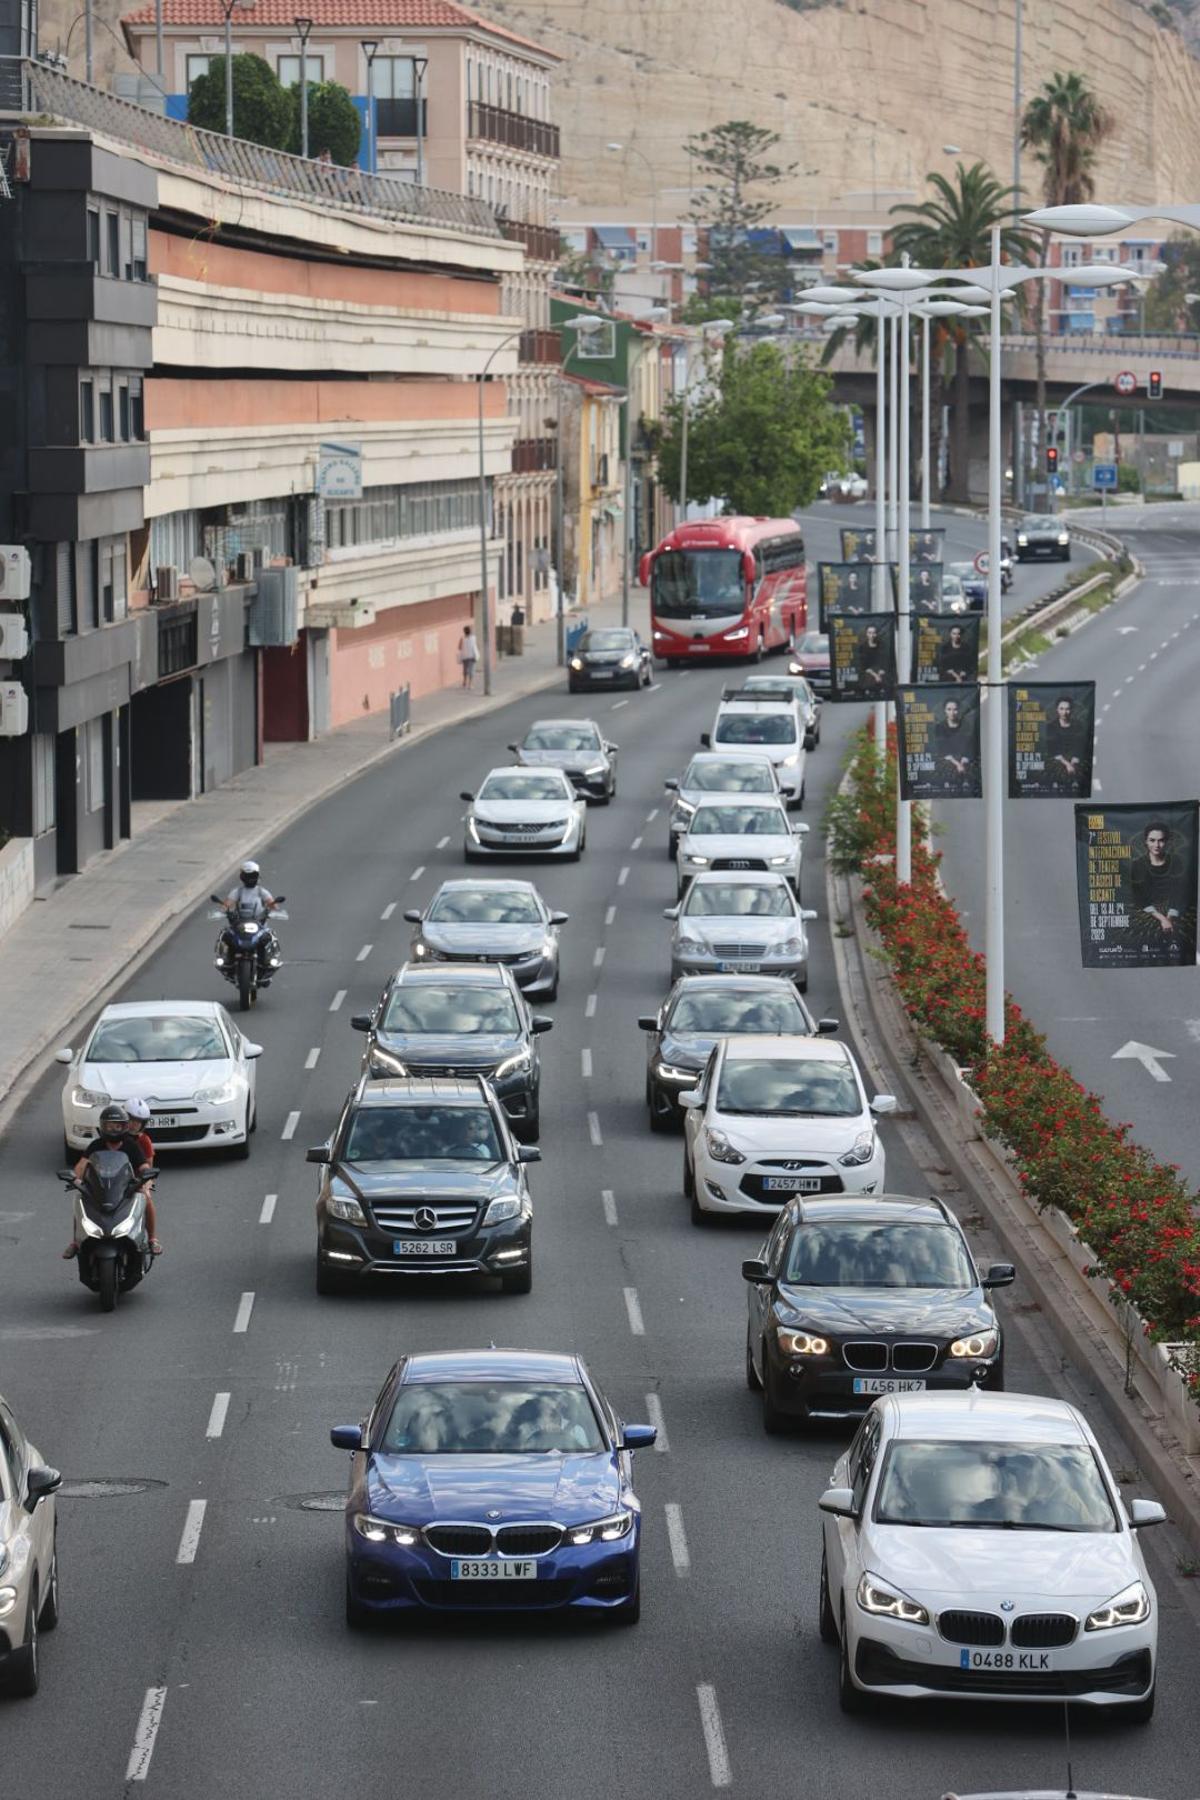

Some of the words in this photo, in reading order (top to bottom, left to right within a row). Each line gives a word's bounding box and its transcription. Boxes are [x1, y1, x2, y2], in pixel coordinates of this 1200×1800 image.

[1097, 831, 1121, 845] FESTIVAL
[1088, 845, 1132, 859] INTERNACIONAL
[1098, 860, 1120, 873] TEATRO
[1089, 888, 1116, 902] ALICANTE
[1116, 902, 1124, 914] 24
[1098, 915, 1129, 928] SEPTIEMBRE
[1090, 928, 1105, 941] 2023
[771, 1179, 796, 1189] 2457
[401, 1242, 429, 1254] 5262
[432, 1242, 453, 1254] LSR
[864, 1381, 895, 1393] 1456
[461, 1562, 499, 1577] 8333
[504, 1562, 532, 1577] LWF
[973, 1652, 1014, 1667] 0488
[1019, 1653, 1049, 1669] KLK
